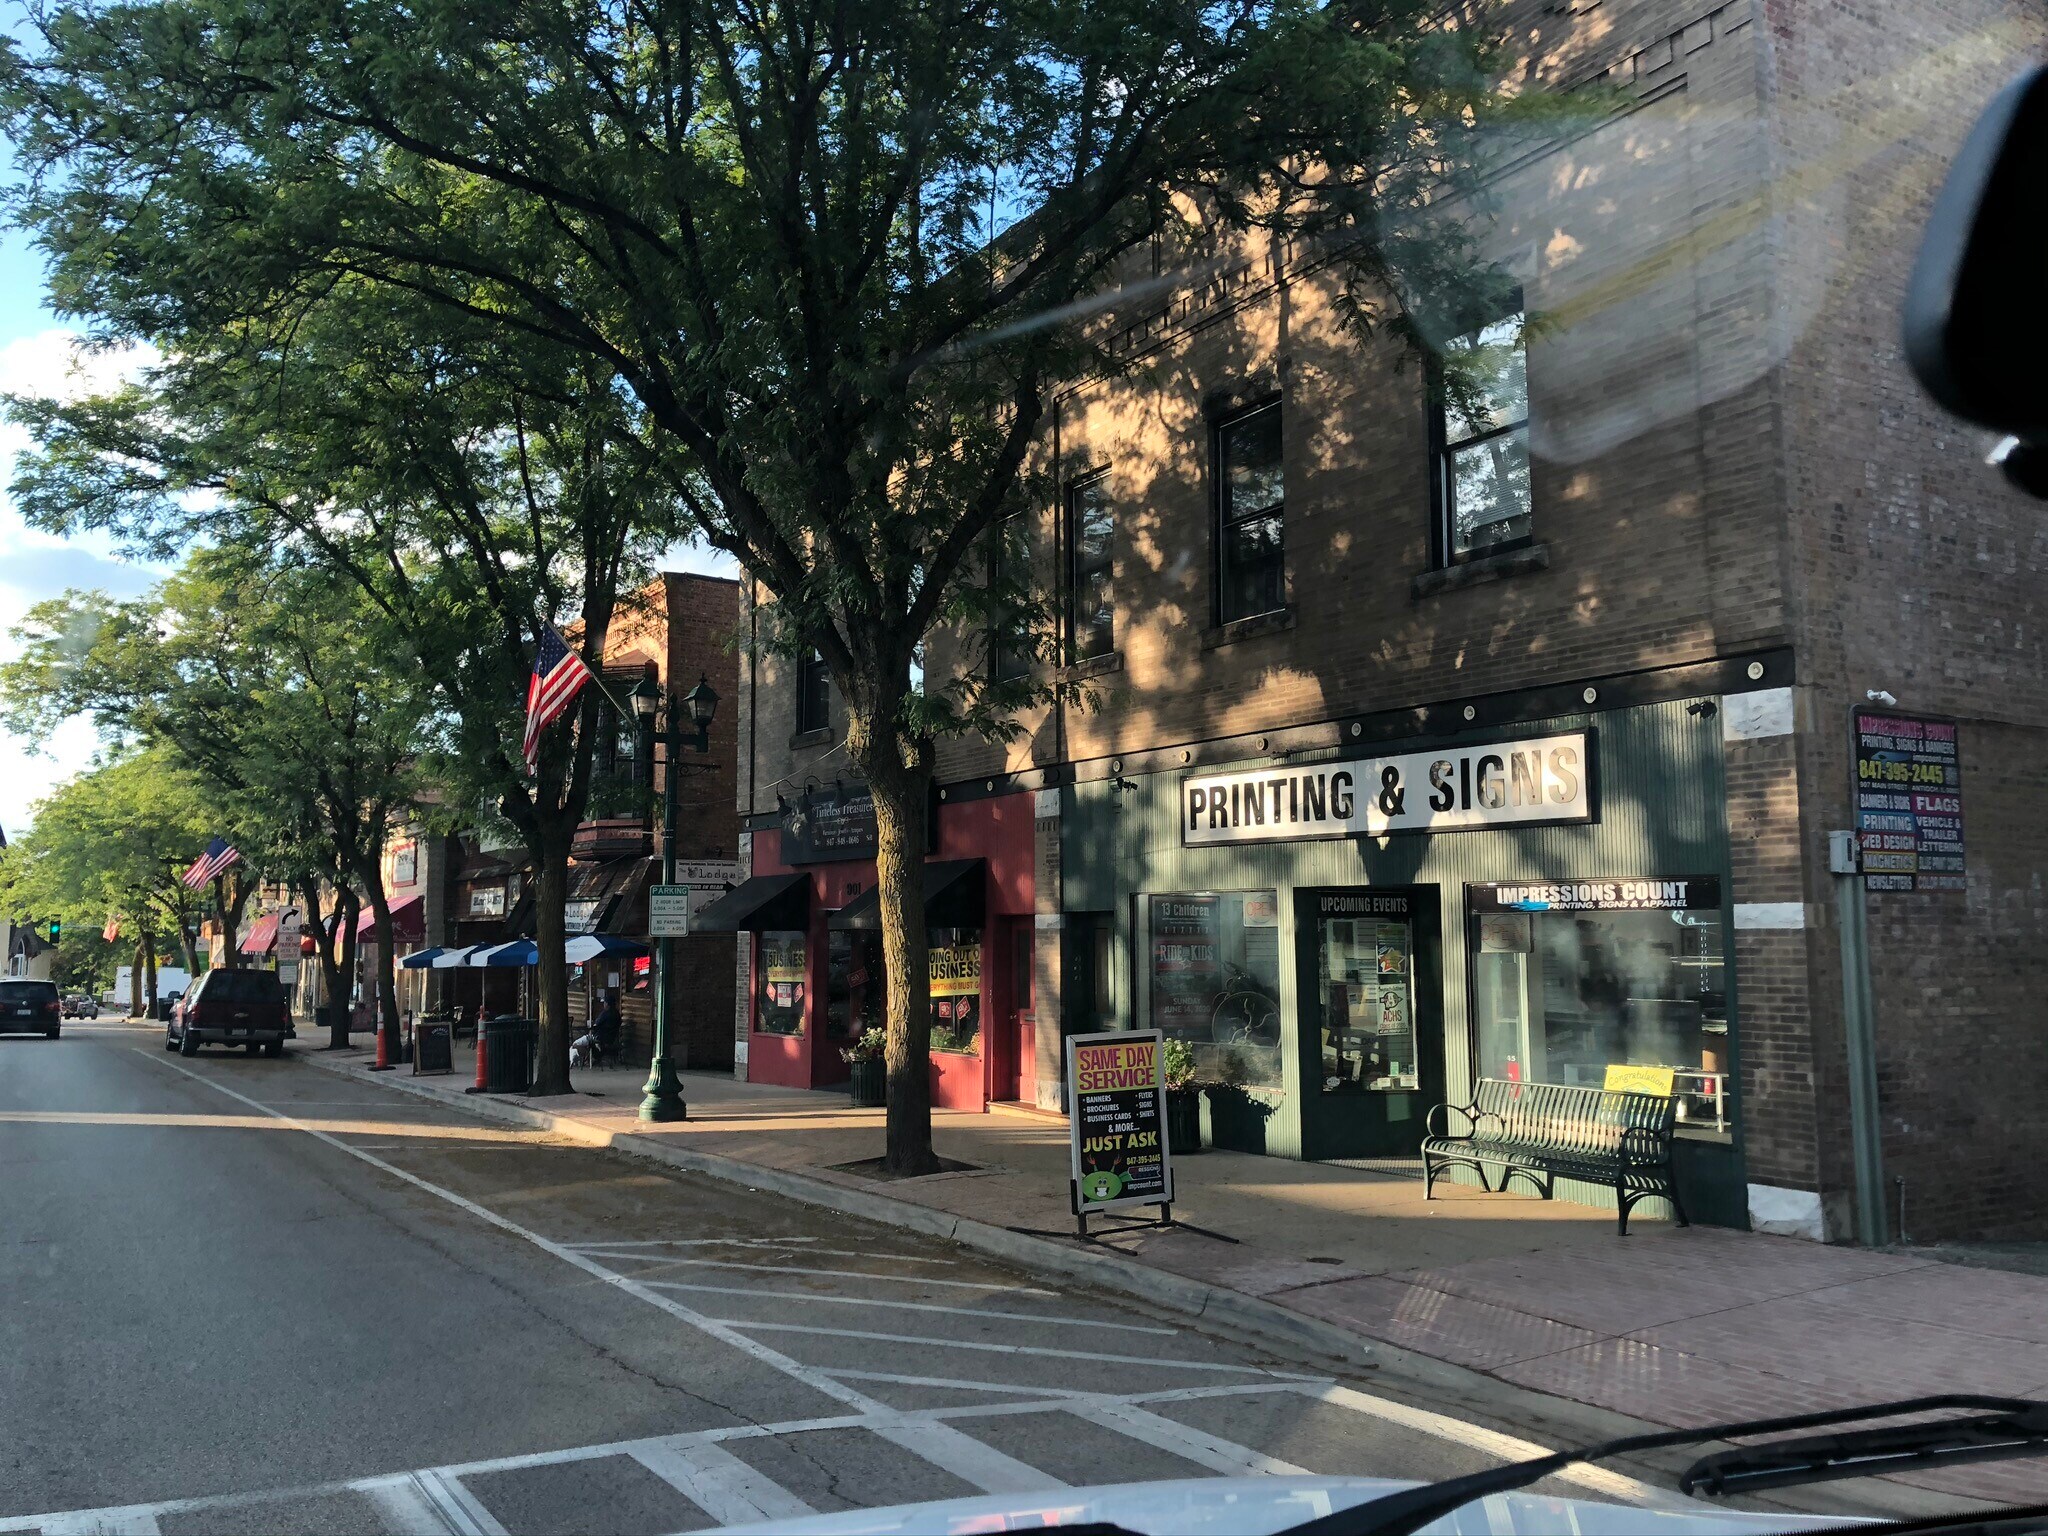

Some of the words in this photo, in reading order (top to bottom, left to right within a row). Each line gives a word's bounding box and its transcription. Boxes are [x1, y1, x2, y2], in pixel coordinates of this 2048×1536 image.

[1896, 738, 1917, 751] SIGNS
[1918, 740, 1924, 752] &
[1925, 741, 1955, 755] BANNERS
[1859, 759, 1944, 784] 847-395-2445
[1190, 770, 1354, 831] PRINTING
[1379, 765, 1405, 817] &
[1428, 747, 1578, 812] SIGNS
[1860, 794, 1888, 809] BANNERS
[1915, 796, 1960, 813] FLAGS
[1863, 814, 1912, 831] PRINTING
[1915, 816, 1954, 828] VEHICLE
[1955, 818, 1961, 829] &
[1922, 829, 1958, 841] TRAILER
[1862, 834, 1881, 849] WEB
[1883, 835, 1915, 850] DESIGN
[1917, 841, 1963, 853] LETTERING
[1867, 875, 1913, 890] NEWSLETTERS
[652, 887, 687, 895] PARKING
[847, 883, 862, 896] 901
[1497, 884, 1616, 904] IMPRESSIONS
[1621, 882, 1689, 901] COUNT
[1161, 902, 1171, 915] 13
[1173, 903, 1210, 917] Children
[1320, 896, 1371, 912] UPCOMING
[1373, 897, 1408, 913] EVENTS
[1548, 901, 1596, 910] PRINTING,
[1597, 901, 1629, 909] SIGNS
[1641, 899, 1688, 908] APPAREL
[930, 950, 951, 964] OING
[953, 950, 970, 961] OUT
[1160, 945, 1183, 961] RIDE
[1190, 945, 1213, 961] KIDS
[930, 960, 980, 980] USINESS
[957, 981, 973, 990] MUST
[1173, 997, 1201, 1005] SUNDAY
[1163, 1006, 1183, 1014] JUNE
[1383, 1010, 1402, 1022] ACHS
[1080, 1048, 1122, 1071] SAME
[1125, 1045, 1154, 1067] DAY
[1079, 1067, 1156, 1090] SERVICE
[1086, 1095, 1112, 1103] BANNERS
[1138, 1091, 1154, 1099] FLYERS
[1086, 1104, 1120, 1113] BROCHURES
[1139, 1101, 1153, 1109] SIGNS
[1087, 1114, 1114, 1122] BUSINESS
[1114, 1112, 1132, 1120] CARDS
[1139, 1110, 1155, 1118] SHIRTS
[1108, 1124, 1114, 1133] &
[1082, 1134, 1123, 1153] JUST
[1127, 1130, 1158, 1148] ASK
